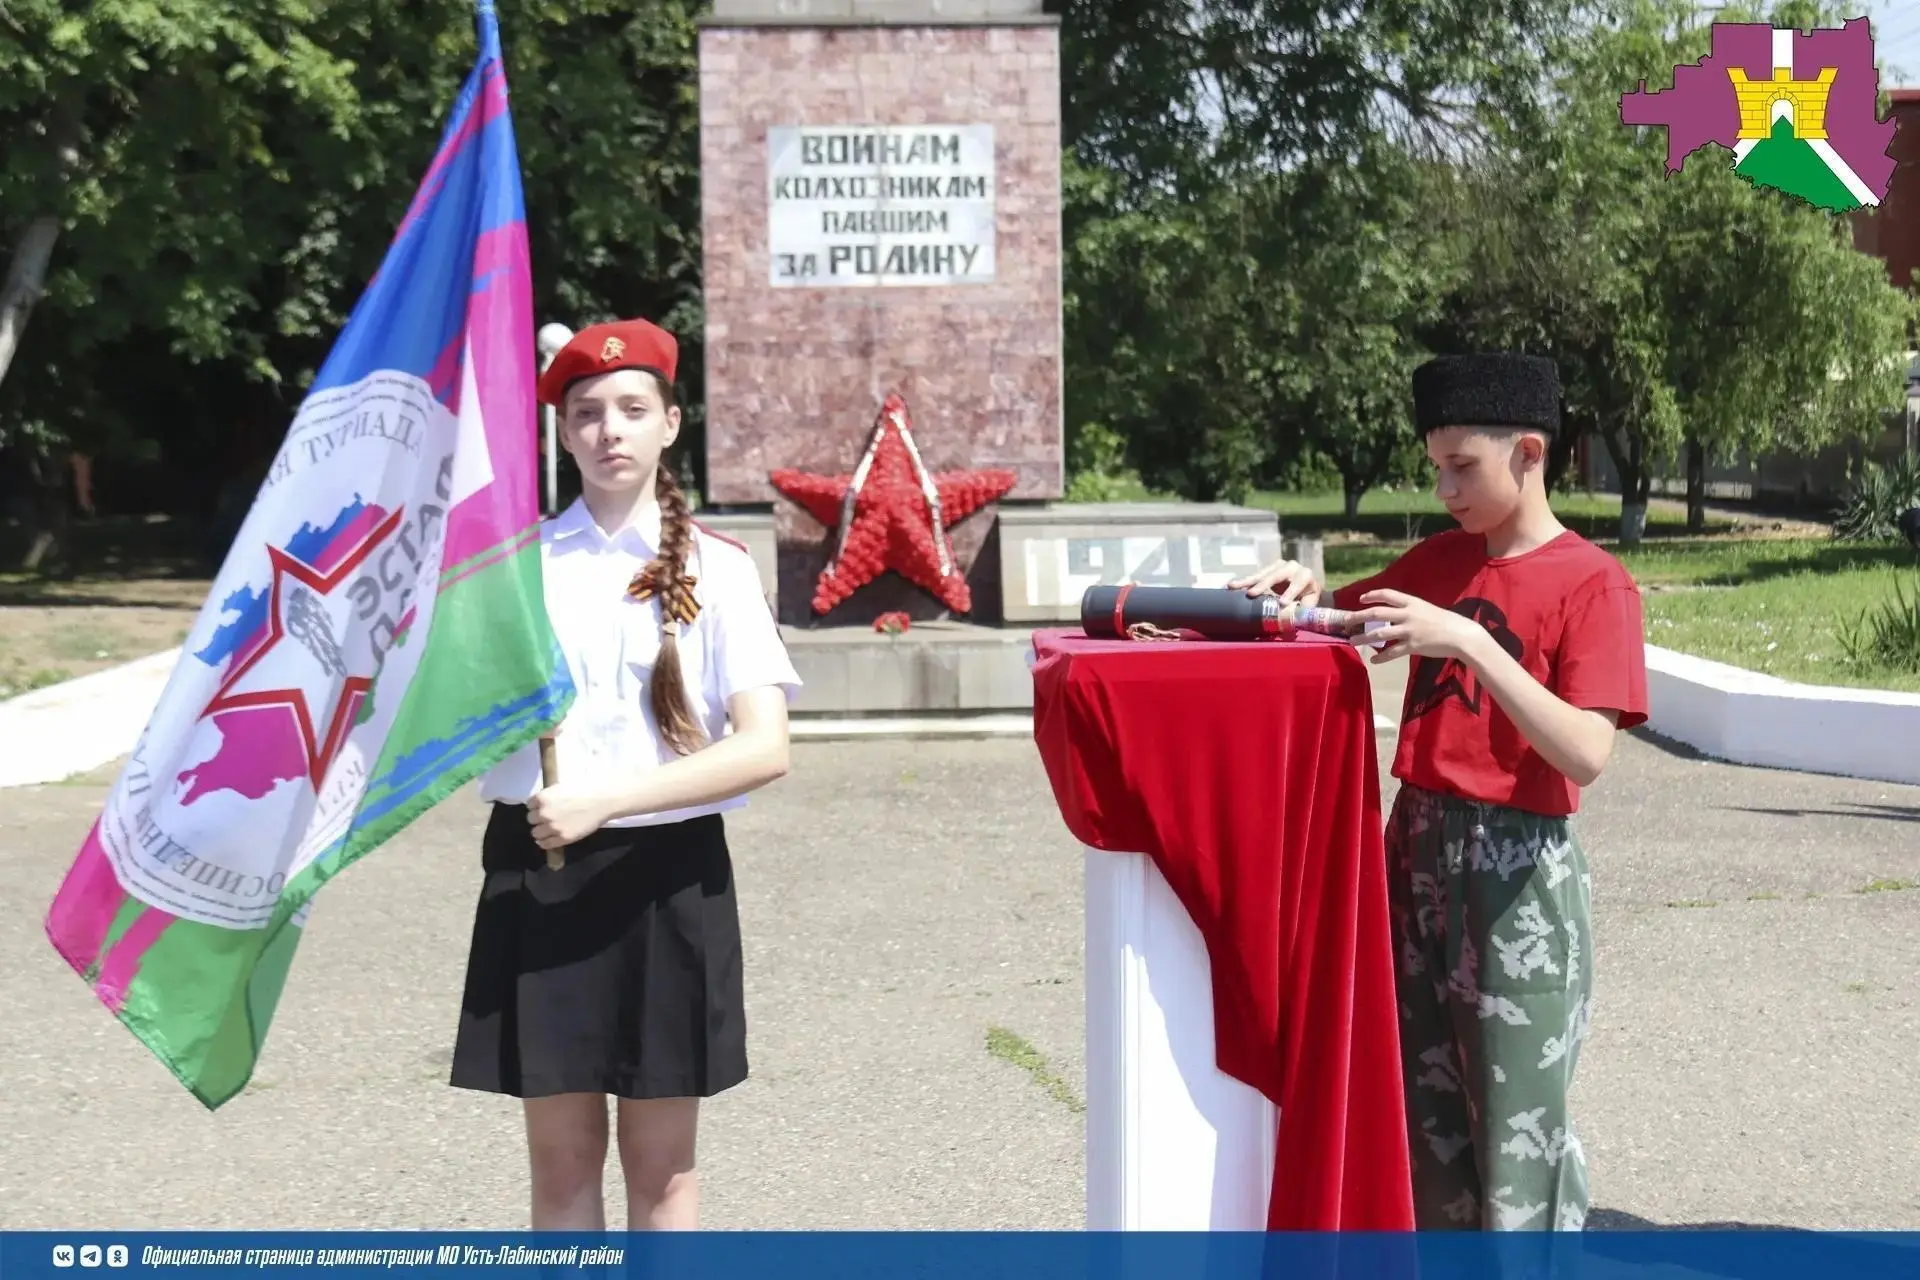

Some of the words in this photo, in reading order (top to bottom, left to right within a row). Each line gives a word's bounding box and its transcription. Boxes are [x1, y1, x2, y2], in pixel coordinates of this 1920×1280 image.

[801, 134, 960, 165] ВОИНАМ
[822, 210, 949, 234] ПАВШИМ
[778, 253, 818, 277] ЗА
[829, 244, 979, 276] РОДИНУ
